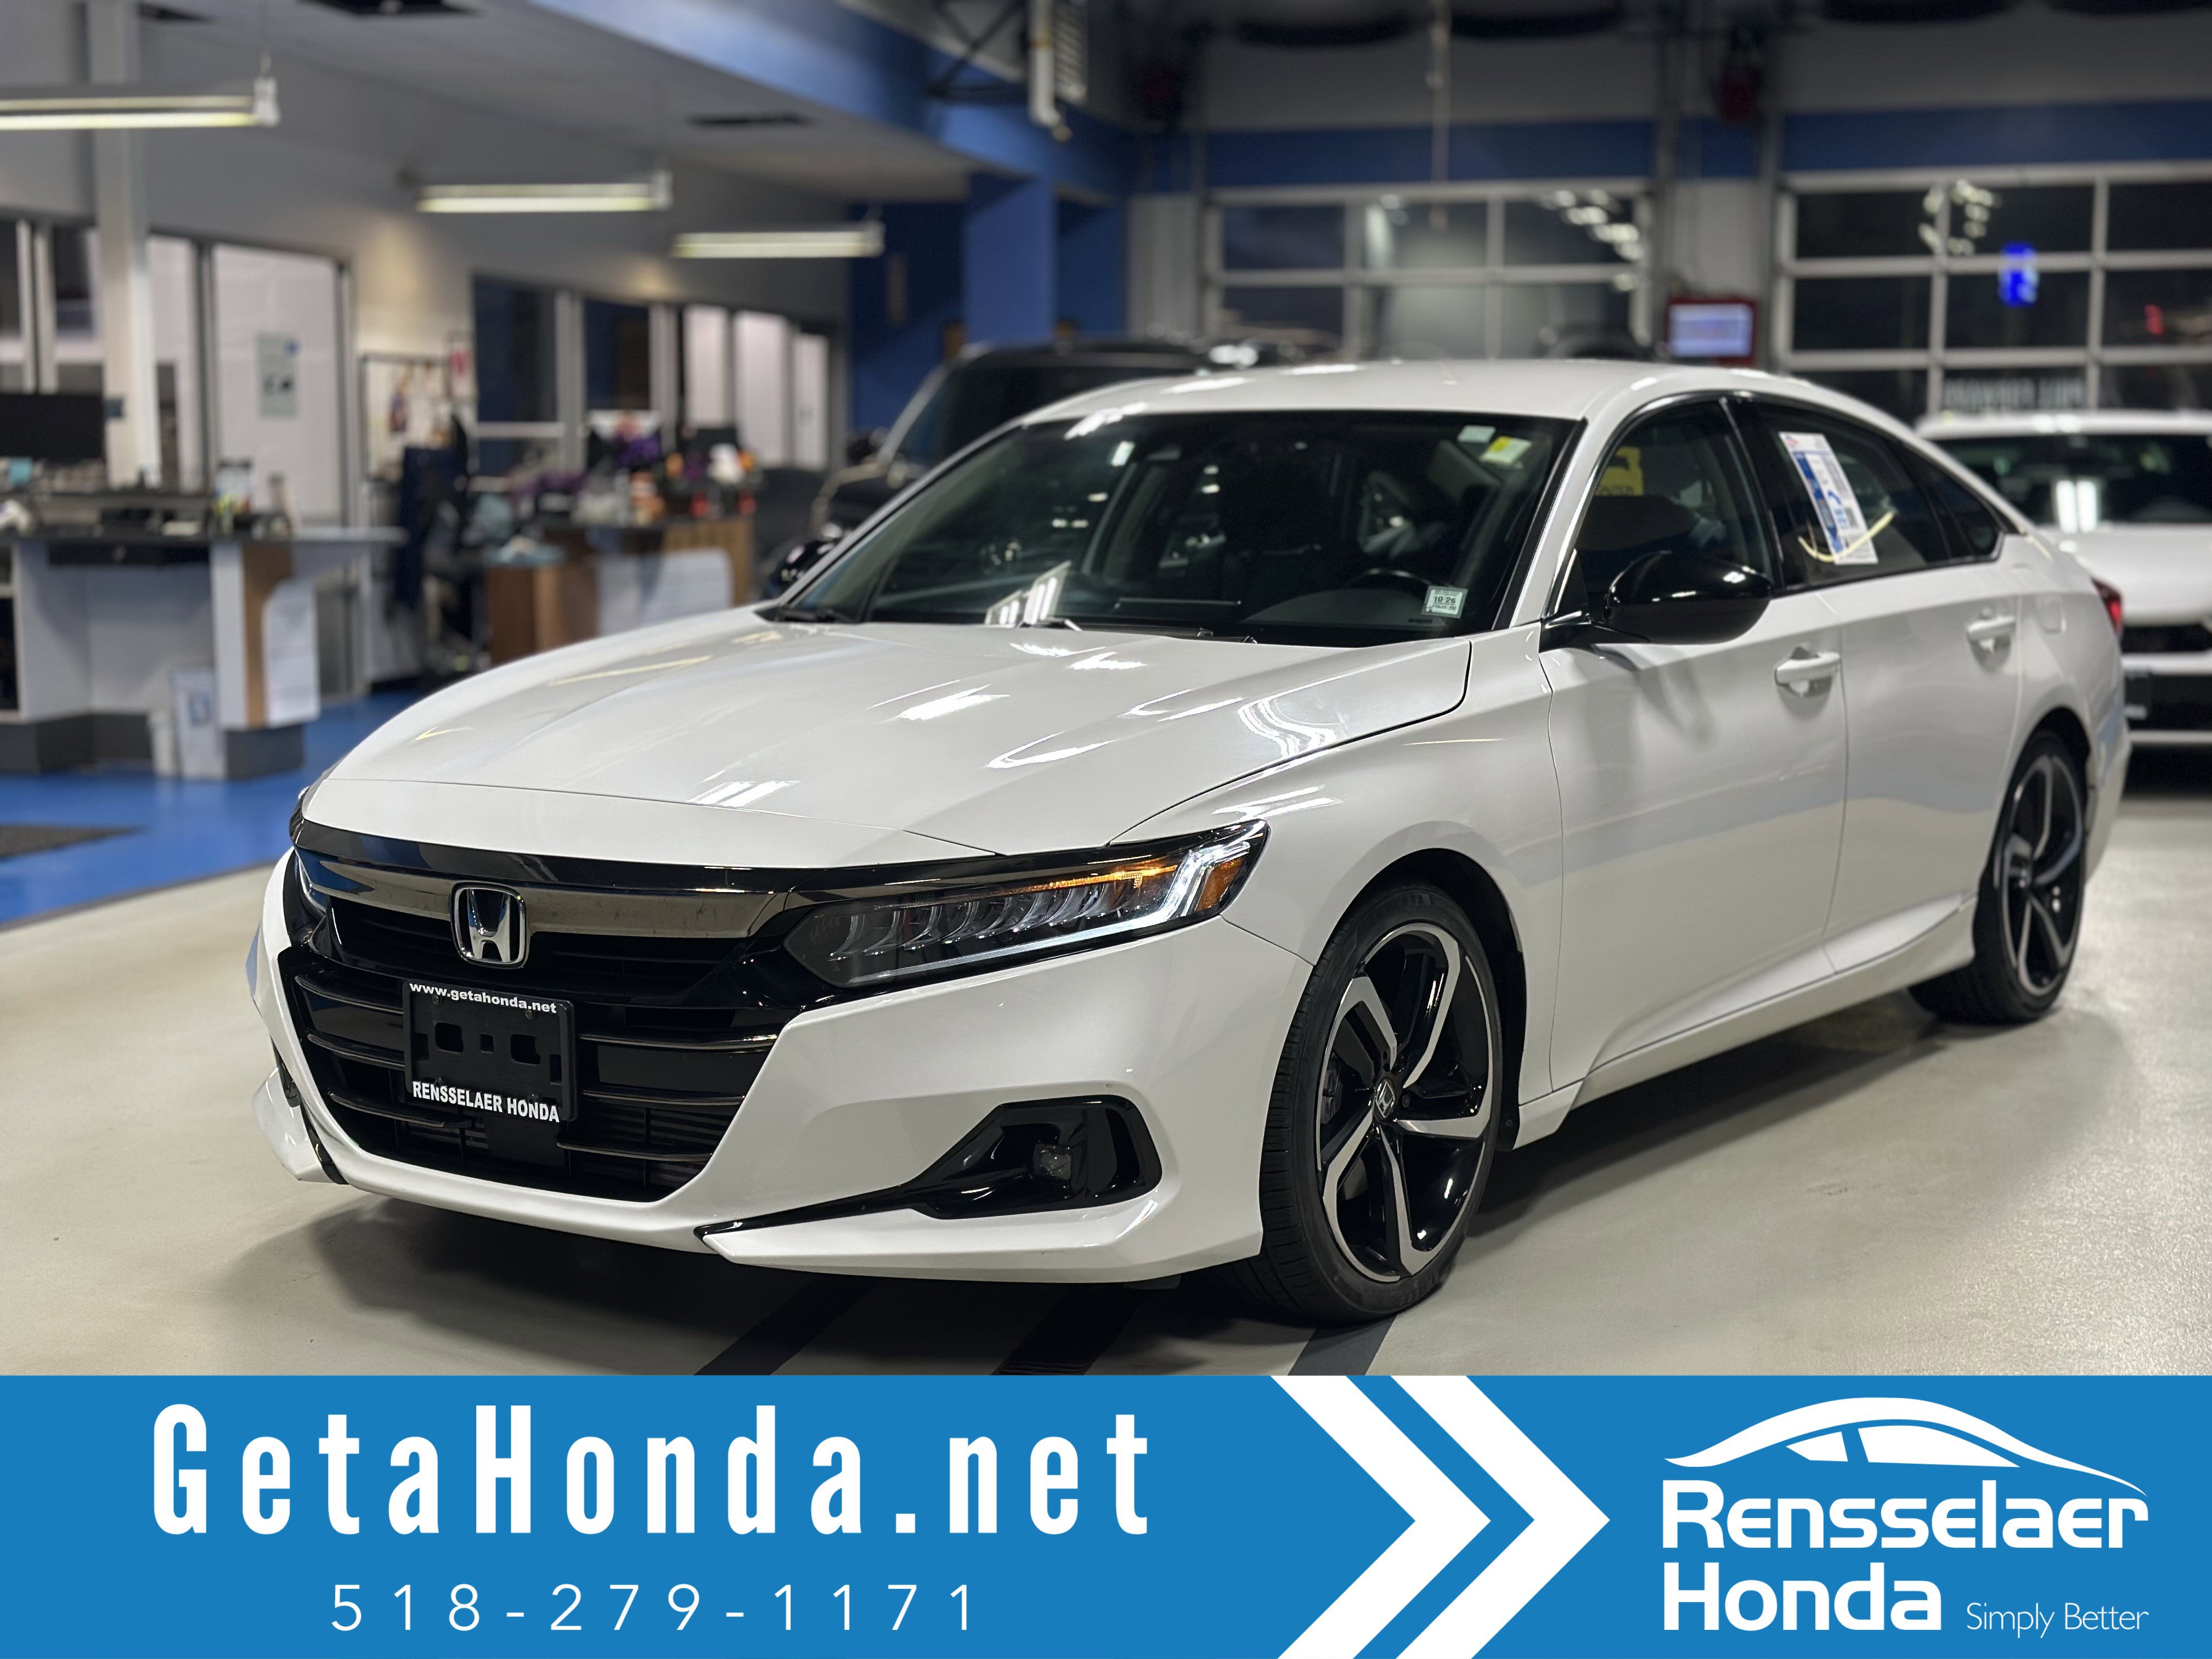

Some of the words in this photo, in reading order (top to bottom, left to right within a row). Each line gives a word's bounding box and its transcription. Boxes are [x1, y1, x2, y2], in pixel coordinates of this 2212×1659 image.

[409, 983, 557, 1013] www.getahonda.net
[412, 1081, 503, 1113] RENSSELAER
[507, 1097, 560, 1123] HONDA
